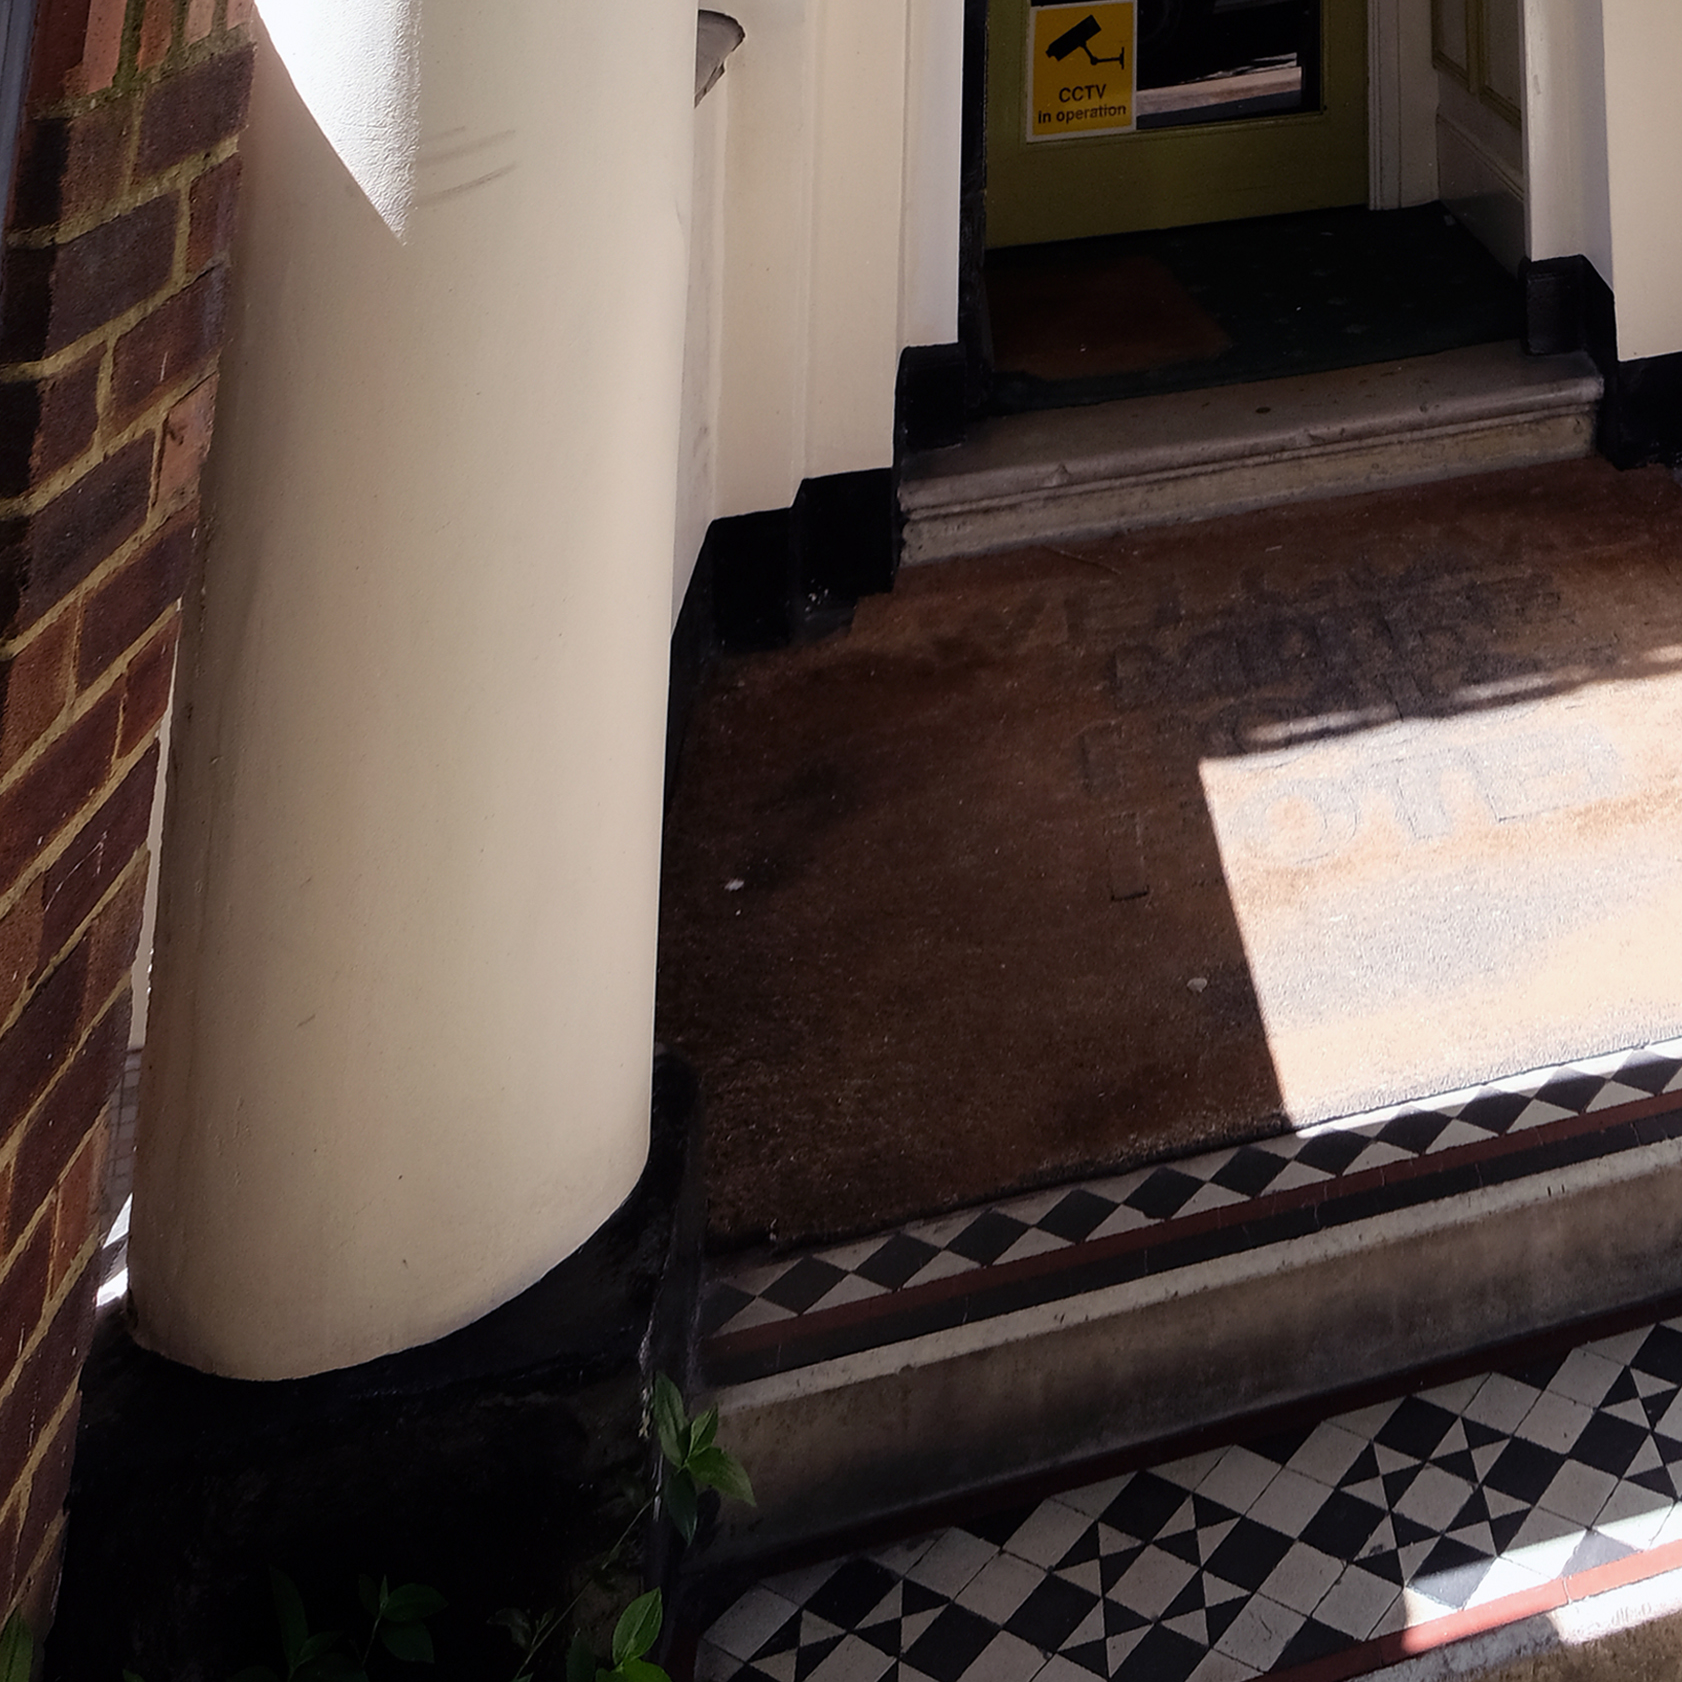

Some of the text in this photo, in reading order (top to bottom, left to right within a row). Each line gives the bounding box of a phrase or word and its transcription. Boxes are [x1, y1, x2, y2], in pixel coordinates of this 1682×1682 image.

[1058, 83, 1107, 103] CCTV
[1038, 104, 1126, 124] in operation
